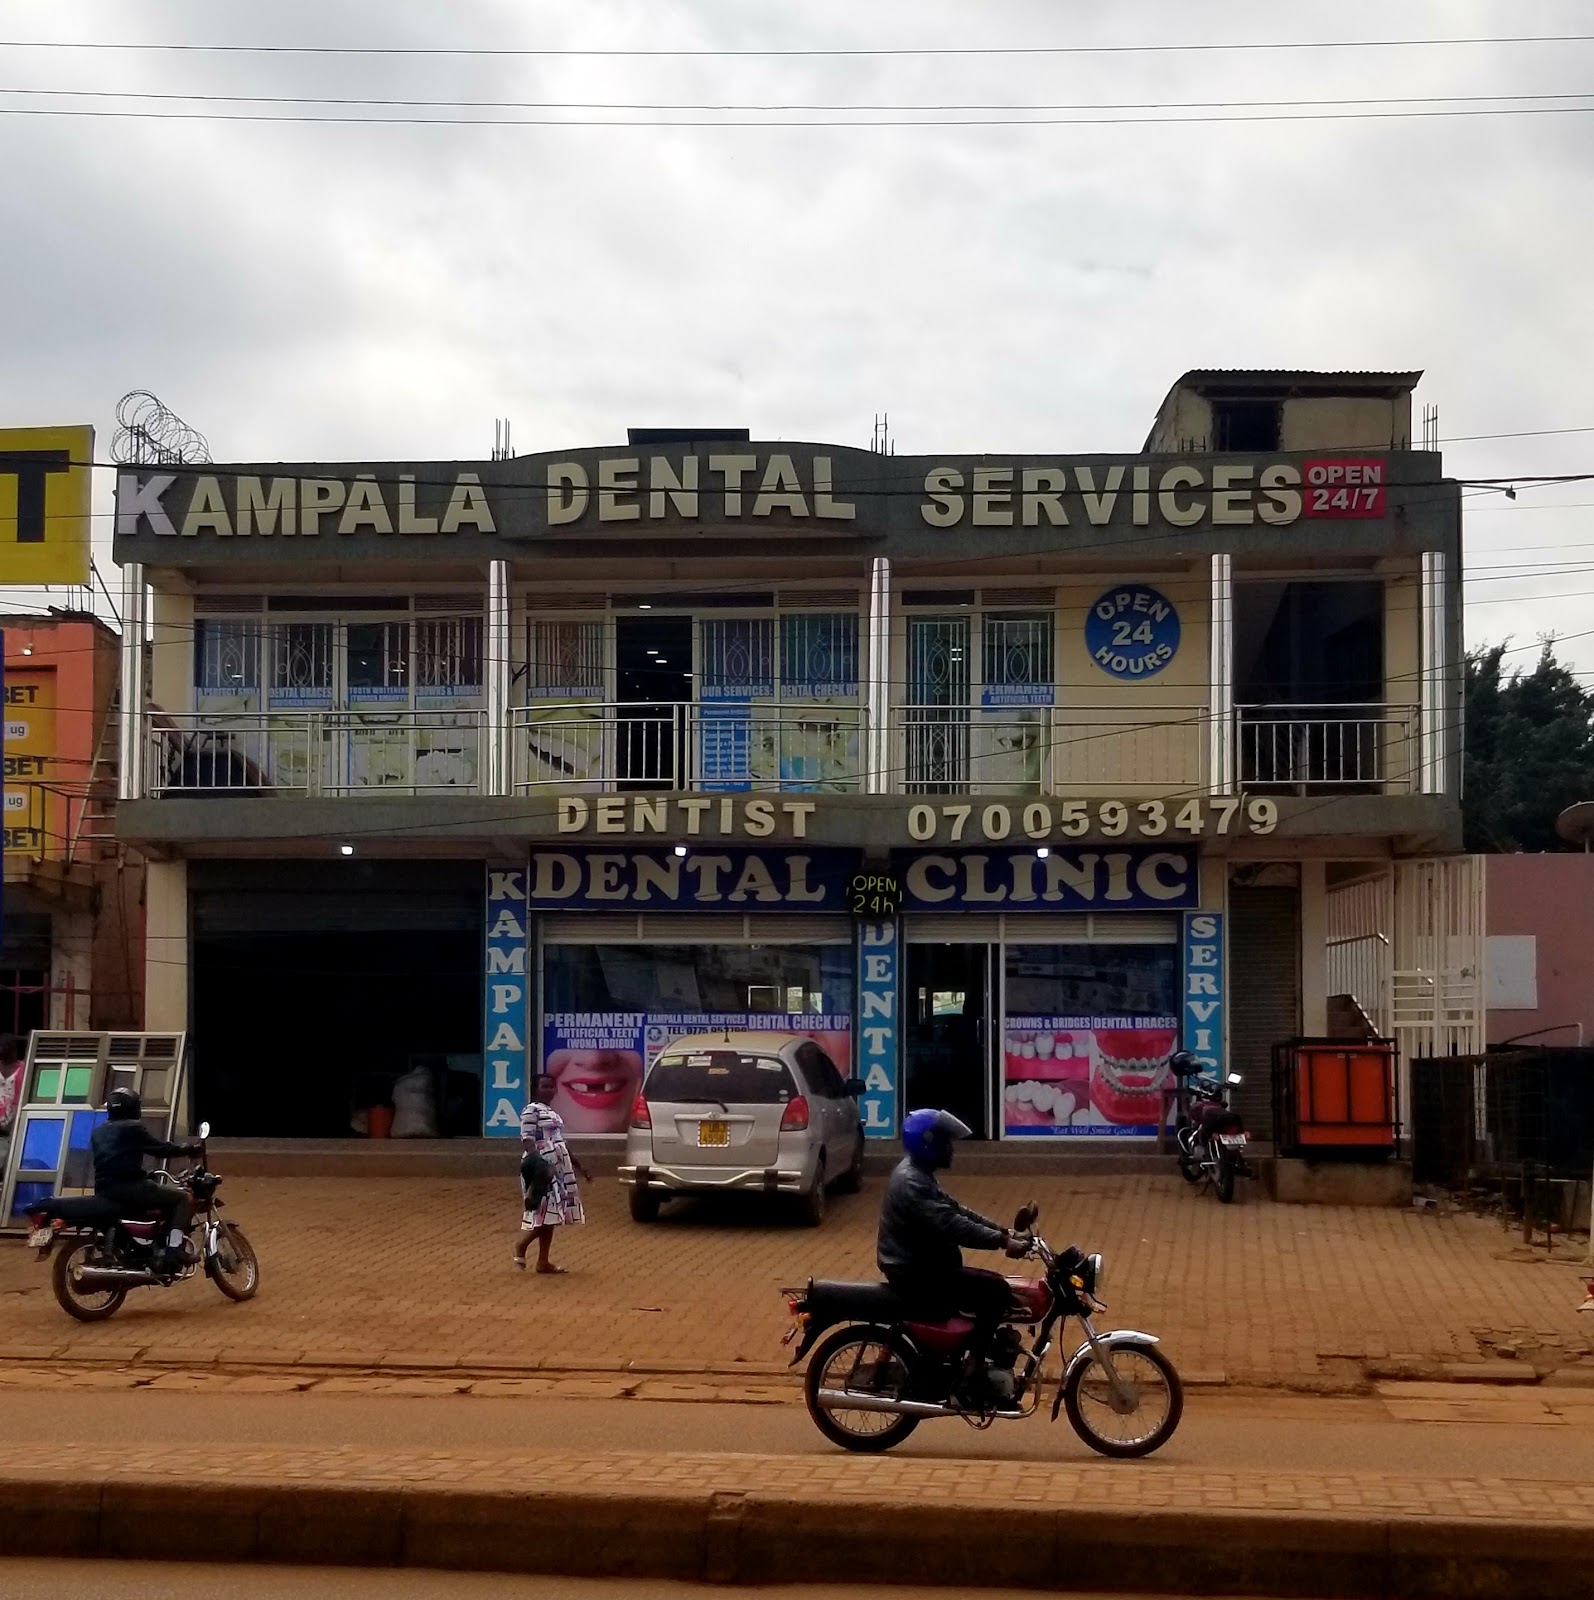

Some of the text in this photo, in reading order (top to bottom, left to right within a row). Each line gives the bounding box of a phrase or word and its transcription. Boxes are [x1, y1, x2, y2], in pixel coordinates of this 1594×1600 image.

[1308, 466, 1381, 485] OPEN
[117, 454, 1303, 536] KAMPALA DENTAL SERVICES
[1312, 488, 1379, 511] 24/7
[1096, 593, 1170, 623] OPEN
[1112, 620, 1154, 646] 24
[1095, 643, 1173, 674] HOURS
[269, 687, 298, 698] DENTAL
[702, 685, 773, 697] OUR SERVICES:
[781, 684, 858, 697] DENTAL CHECK UP
[983, 686, 1053, 695] PERMANENT
[558, 797, 1279, 841] DENTIST 0700593479
[531, 853, 826, 902] DENTAL
[853, 875, 897, 893] OPEN
[906, 853, 1188, 903] CLINIC
[486, 872, 526, 1127] KAMPALA
[1186, 916, 1220, 1079] SERVIC
[544, 1012, 645, 1027] PERMANENT
[647, 1014, 682, 1024] KAMPALA
[683, 1014, 709, 1024] DENTAL
[748, 1015, 850, 1029] DENTAL CHECK UP
[862, 921, 895, 1128] DENTAL
[1005, 1017, 1091, 1029] CROWNS & BRIDGES
[1094, 1017, 1178, 1029] DENTAL BRACES
[557, 1028, 640, 1038] ARTIFICIAL TEETH
[667, 1026, 685, 1035] TEL:
